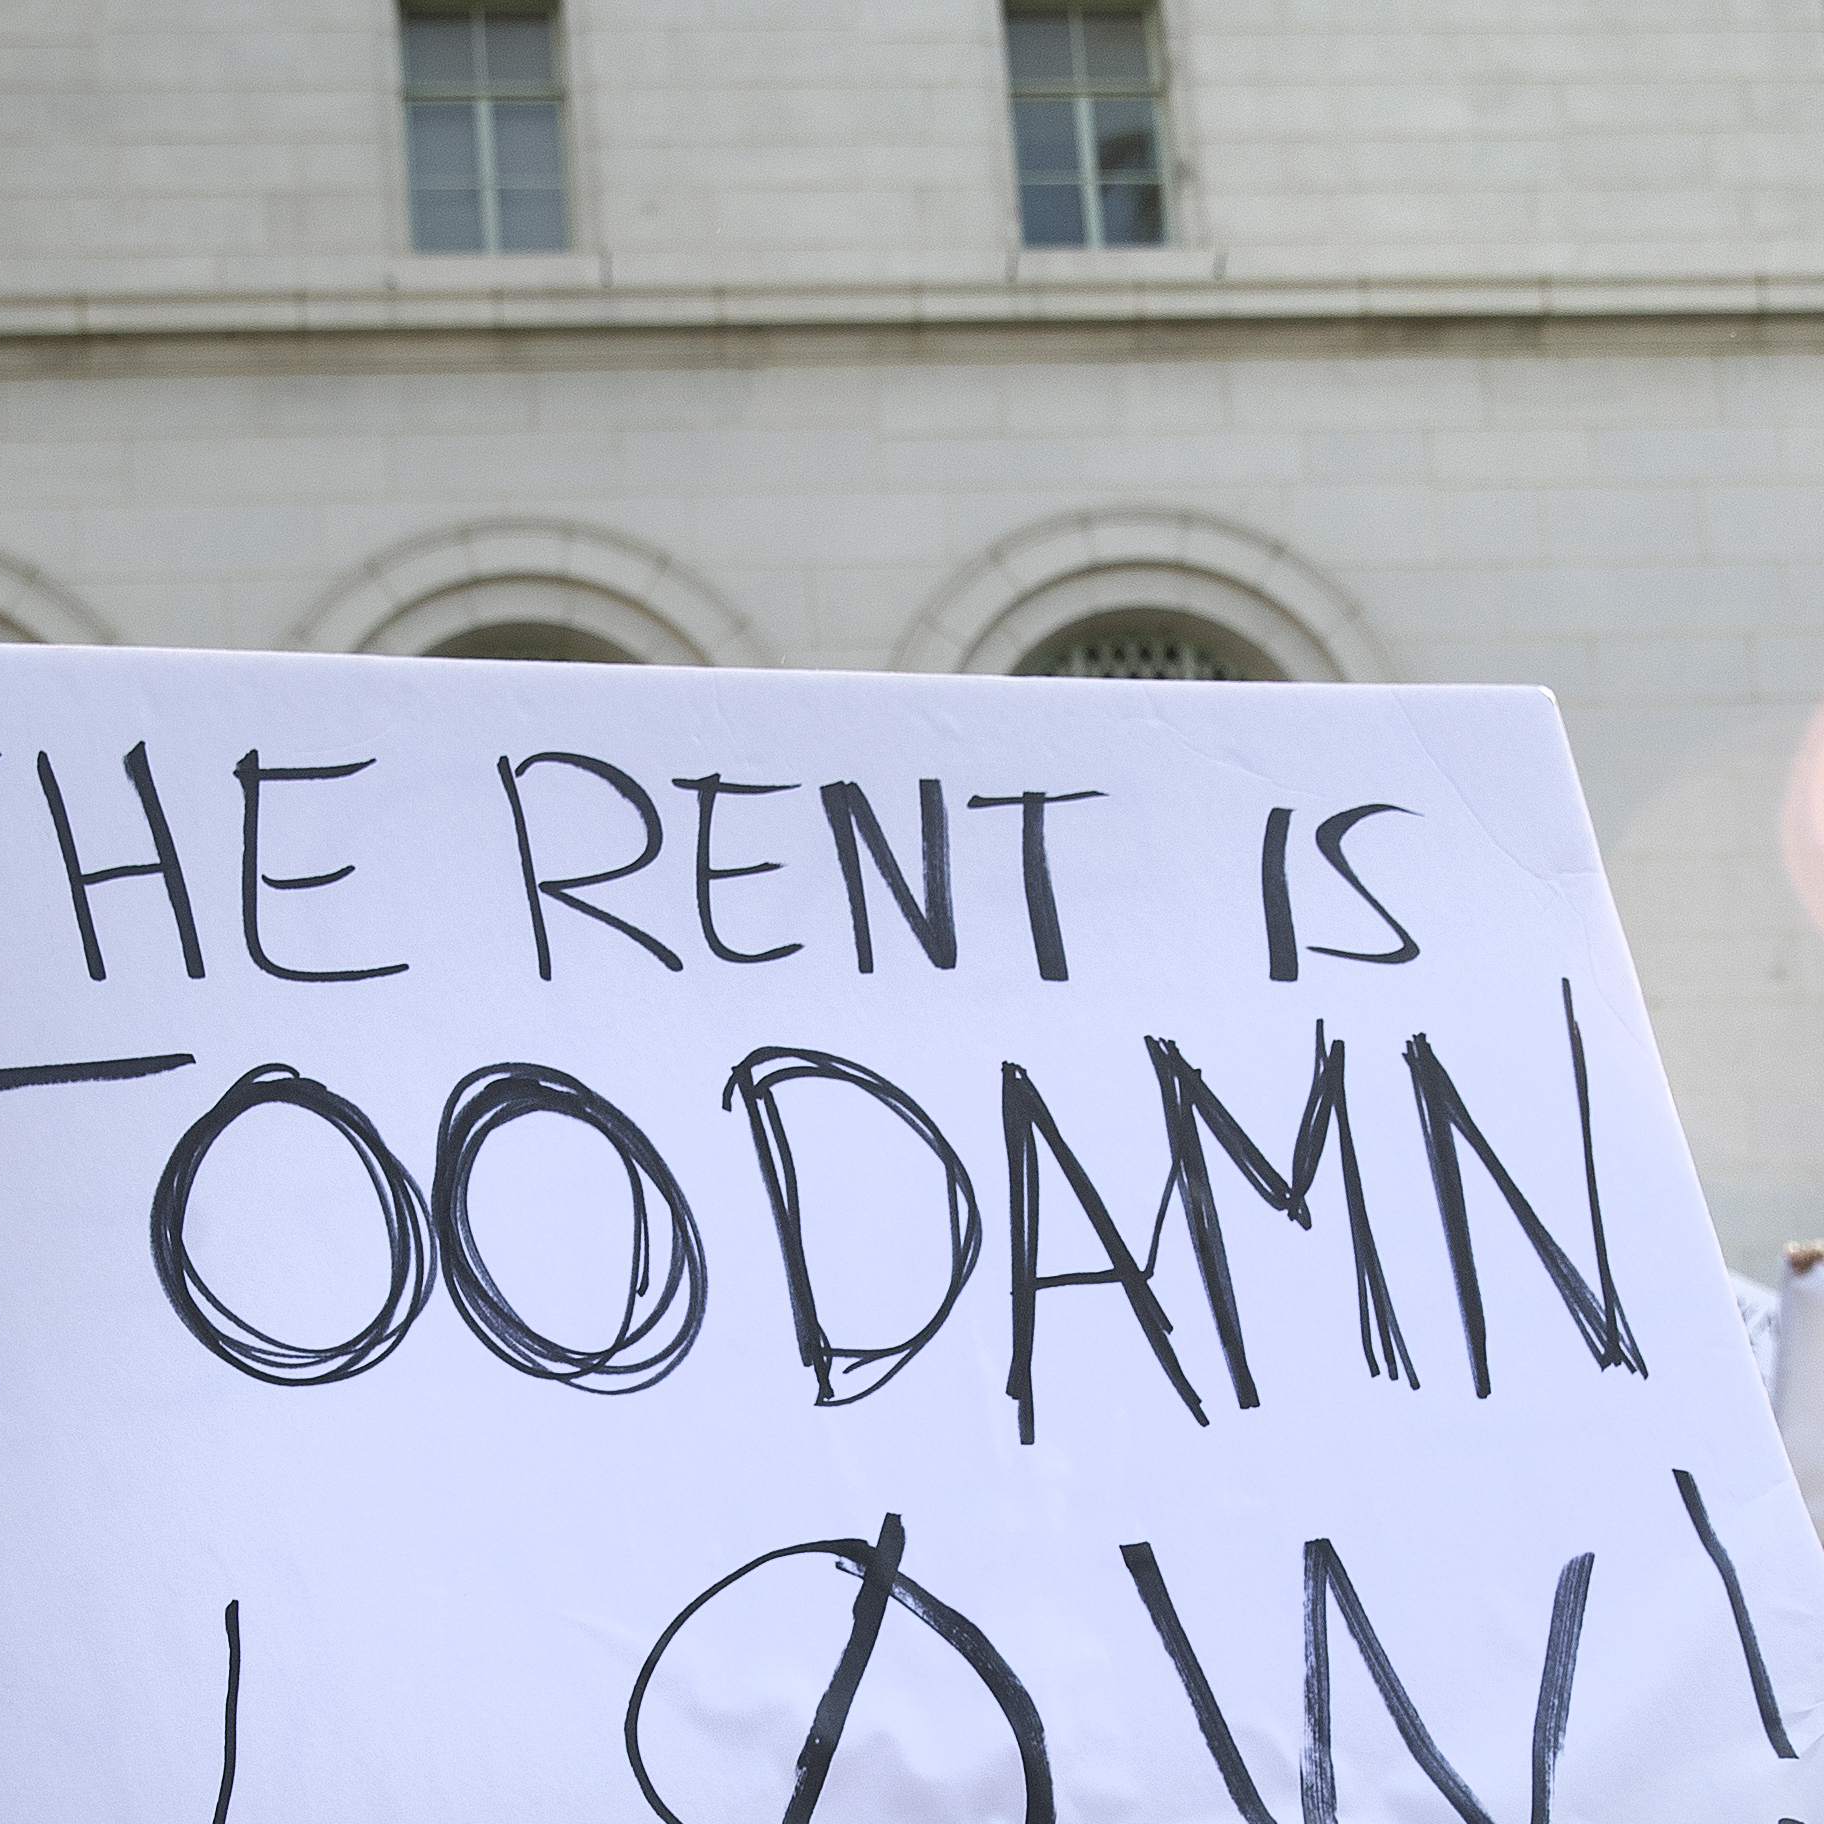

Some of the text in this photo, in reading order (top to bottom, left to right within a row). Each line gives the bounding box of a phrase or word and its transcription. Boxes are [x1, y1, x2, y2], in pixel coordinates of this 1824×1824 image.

[497, 750, 1108, 983] RENT
[1259, 803, 1424, 983] IS
[721, 977, 1649, 1447] DAMN
